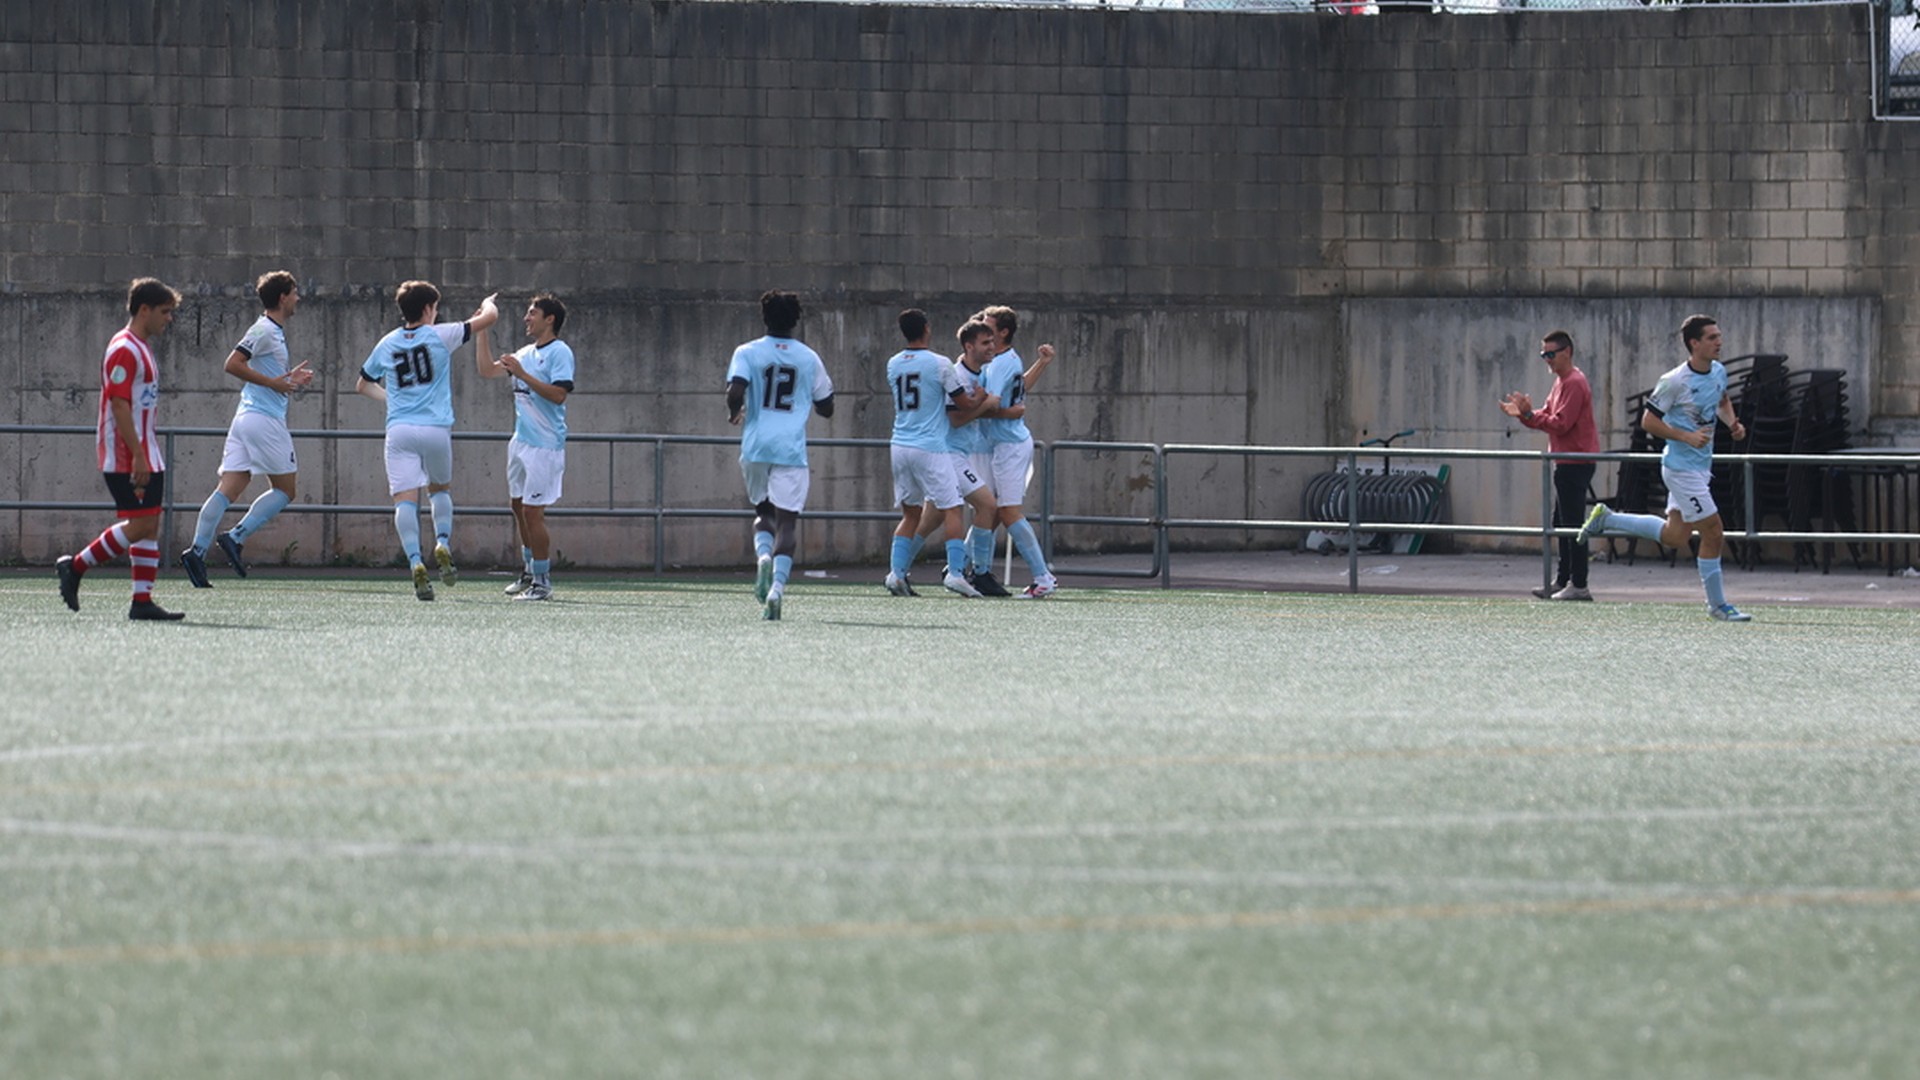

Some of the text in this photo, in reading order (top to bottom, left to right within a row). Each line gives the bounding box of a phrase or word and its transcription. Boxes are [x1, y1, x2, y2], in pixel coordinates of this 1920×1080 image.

[392, 343, 433, 388] 20
[762, 363, 797, 412] 12
[896, 373, 920, 411] 15
[963, 469, 978, 484] 6
[1690, 496, 1703, 514] 3
